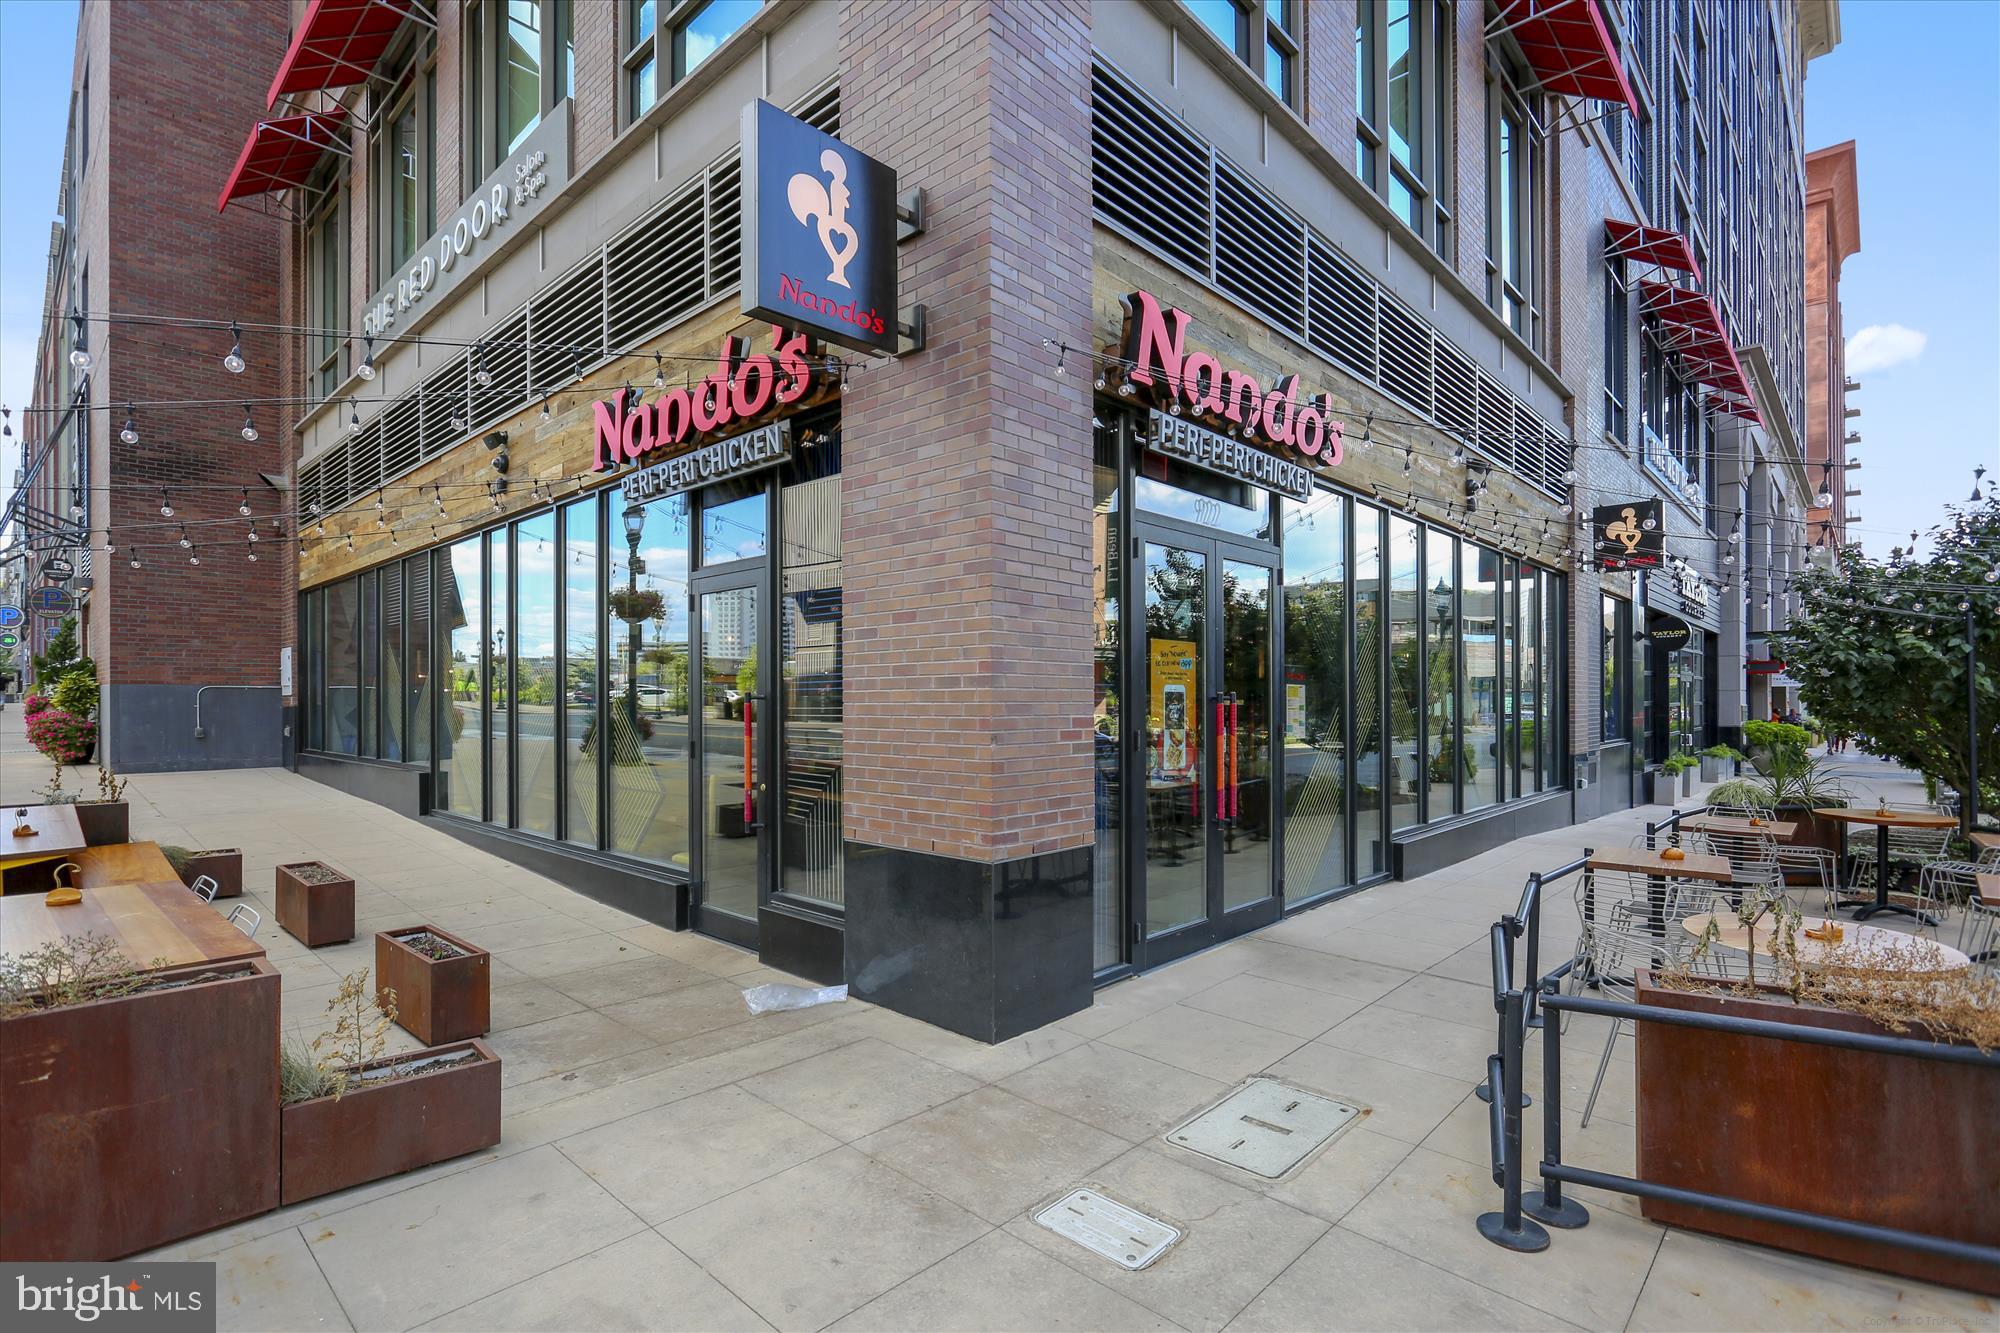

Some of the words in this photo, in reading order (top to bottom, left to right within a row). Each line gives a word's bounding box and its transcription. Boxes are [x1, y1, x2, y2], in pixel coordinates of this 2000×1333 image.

[514, 186, 526, 206] &
[524, 172, 546, 199] Spa
[516, 151, 545, 182] Salon
[363, 292, 395, 337] THE
[398, 256, 436, 313] RED
[441, 183, 509, 273] DOOR
[778, 272, 886, 335] Nando's
[591, 324, 810, 473] Nando's
[1131, 290, 1345, 468] Nando's
[620, 459, 698, 500] PERI-PERI
[698, 426, 785, 478] CHICKEN
[1159, 414, 1252, 479] PERI-PERI
[1253, 449, 1315, 499] CHICKEN
[1, 608, 18, 625] P
[44, 591, 63, 608] P
